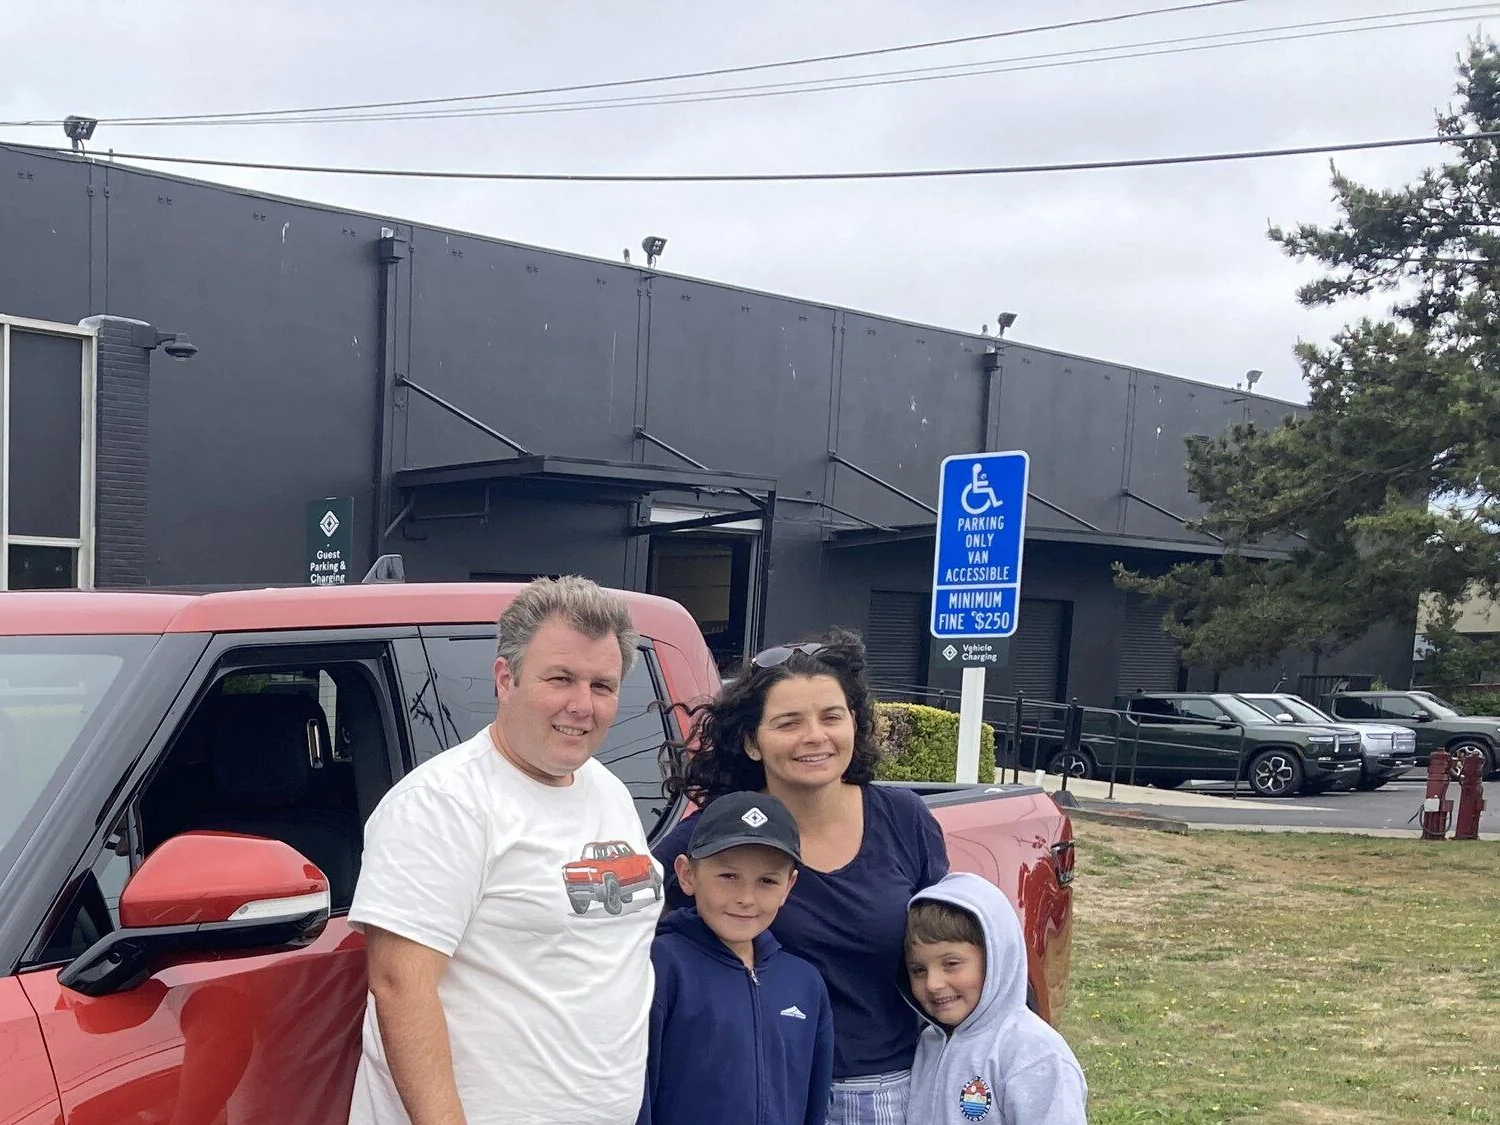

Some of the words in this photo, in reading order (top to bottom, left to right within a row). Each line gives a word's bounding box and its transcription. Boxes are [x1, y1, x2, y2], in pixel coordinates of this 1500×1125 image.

[957, 515, 1004, 532] PARKING
[965, 533, 994, 548] ONLY
[316, 550, 340, 560] Guest
[968, 550, 988, 565] VAN
[310, 561, 339, 573] Parking
[339, 561, 346, 570] &
[945, 566, 1010, 582] ACCESSIBLE
[310, 573, 345, 584] Charging
[948, 591, 1003, 609] MINIMUM
[939, 613, 965, 630] FINE
[974, 612, 1010, 630] $250
[962, 644, 993, 652] Vehicle
[961, 652, 998, 662] Charging
